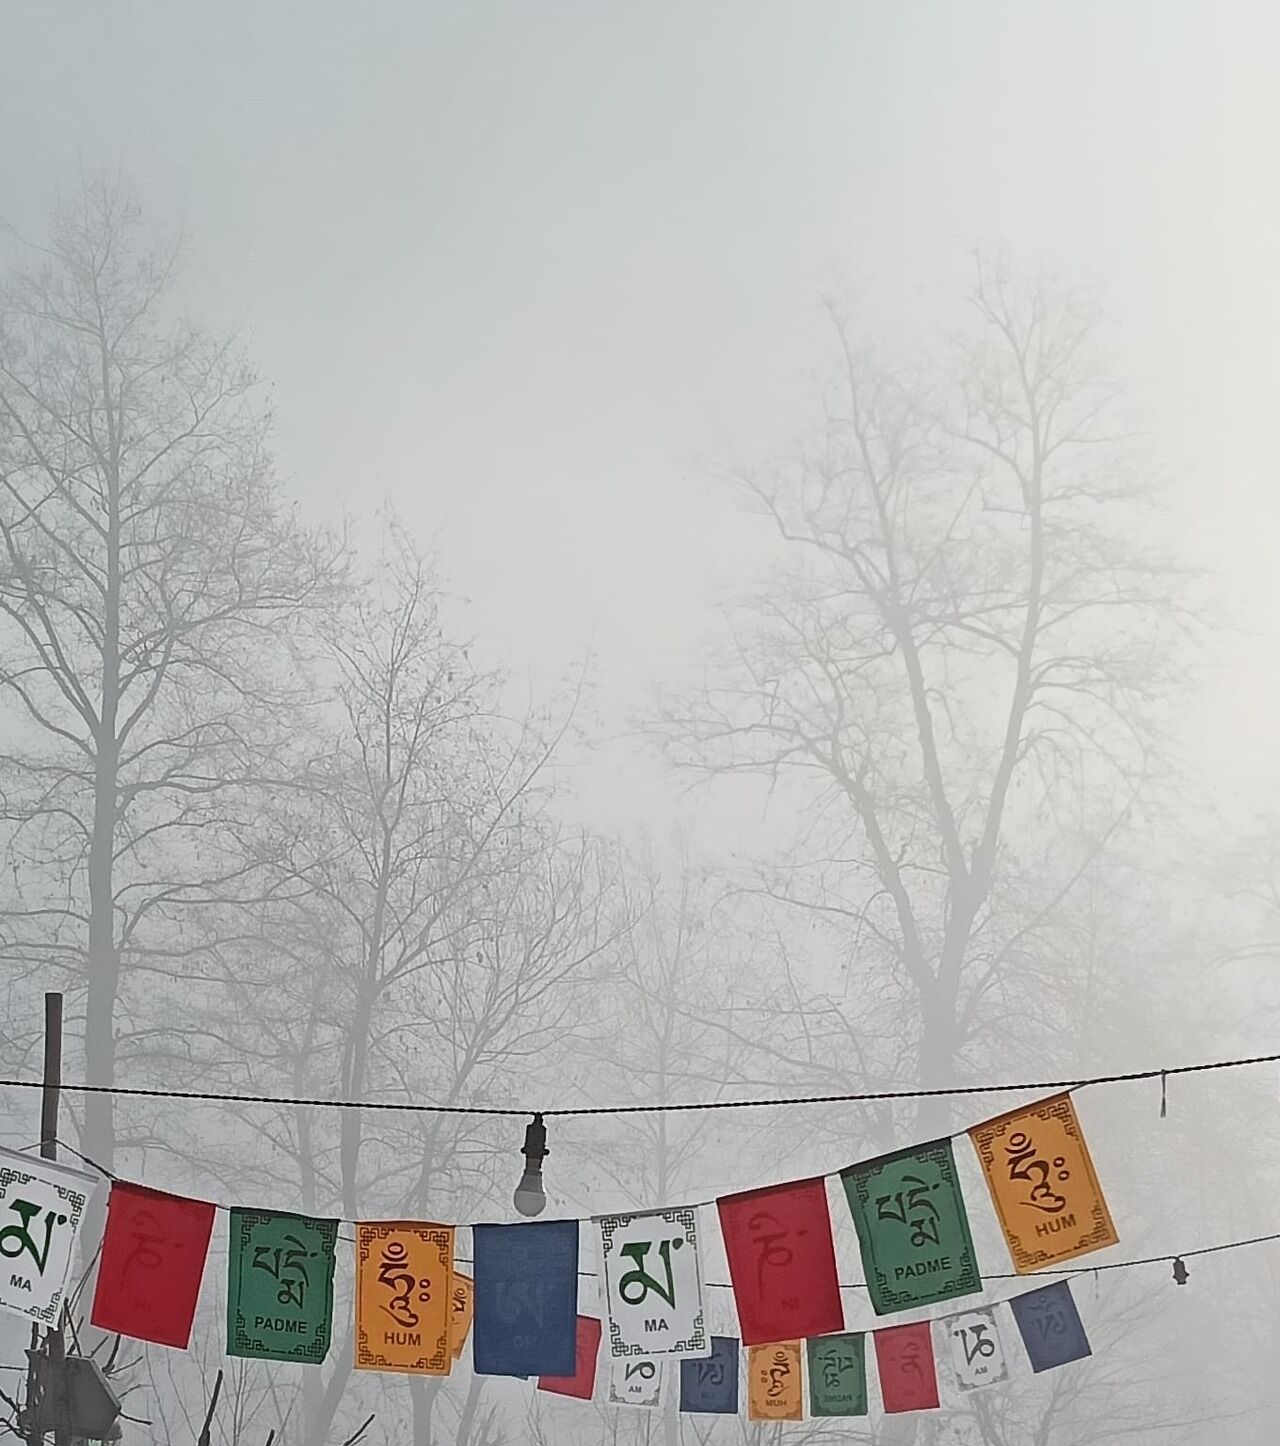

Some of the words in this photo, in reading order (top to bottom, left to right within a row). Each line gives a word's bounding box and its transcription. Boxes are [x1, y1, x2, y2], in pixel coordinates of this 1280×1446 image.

[1034, 1214, 1078, 1238] HUM
[894, 1257, 952, 1280] PADME
[9, 1274, 32, 1292] MA
[781, 1297, 799, 1310] NI
[254, 1316, 308, 1334] PADME
[644, 1319, 669, 1332] MA
[383, 1331, 421, 1346] HUM
